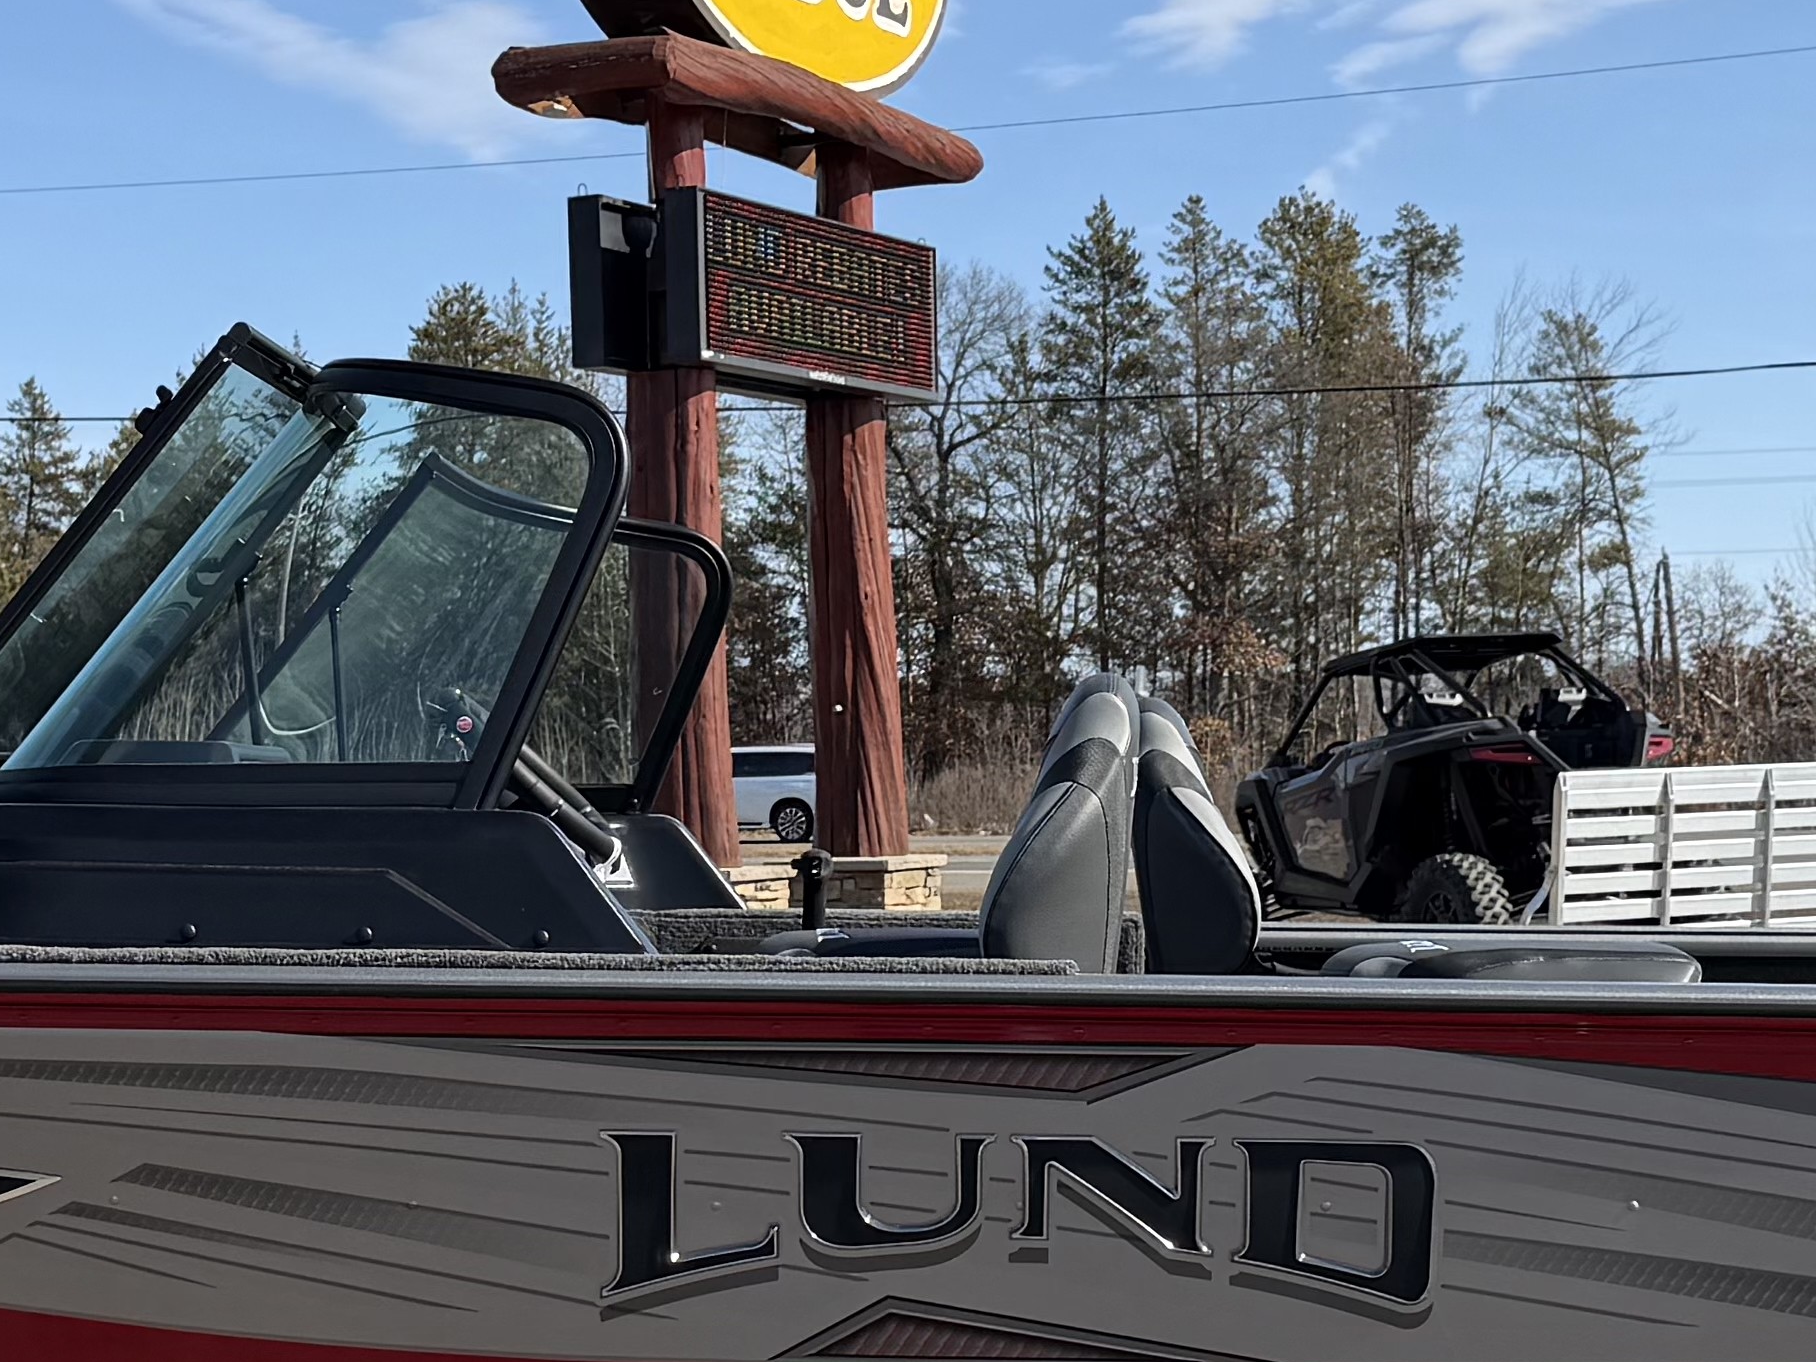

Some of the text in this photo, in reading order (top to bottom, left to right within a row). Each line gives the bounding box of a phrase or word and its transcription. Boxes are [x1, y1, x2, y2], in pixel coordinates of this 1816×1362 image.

[795, 233, 921, 309] REBATES
[727, 282, 906, 363] AVAILABLE!
[599, 1129, 1440, 1322] LUND
